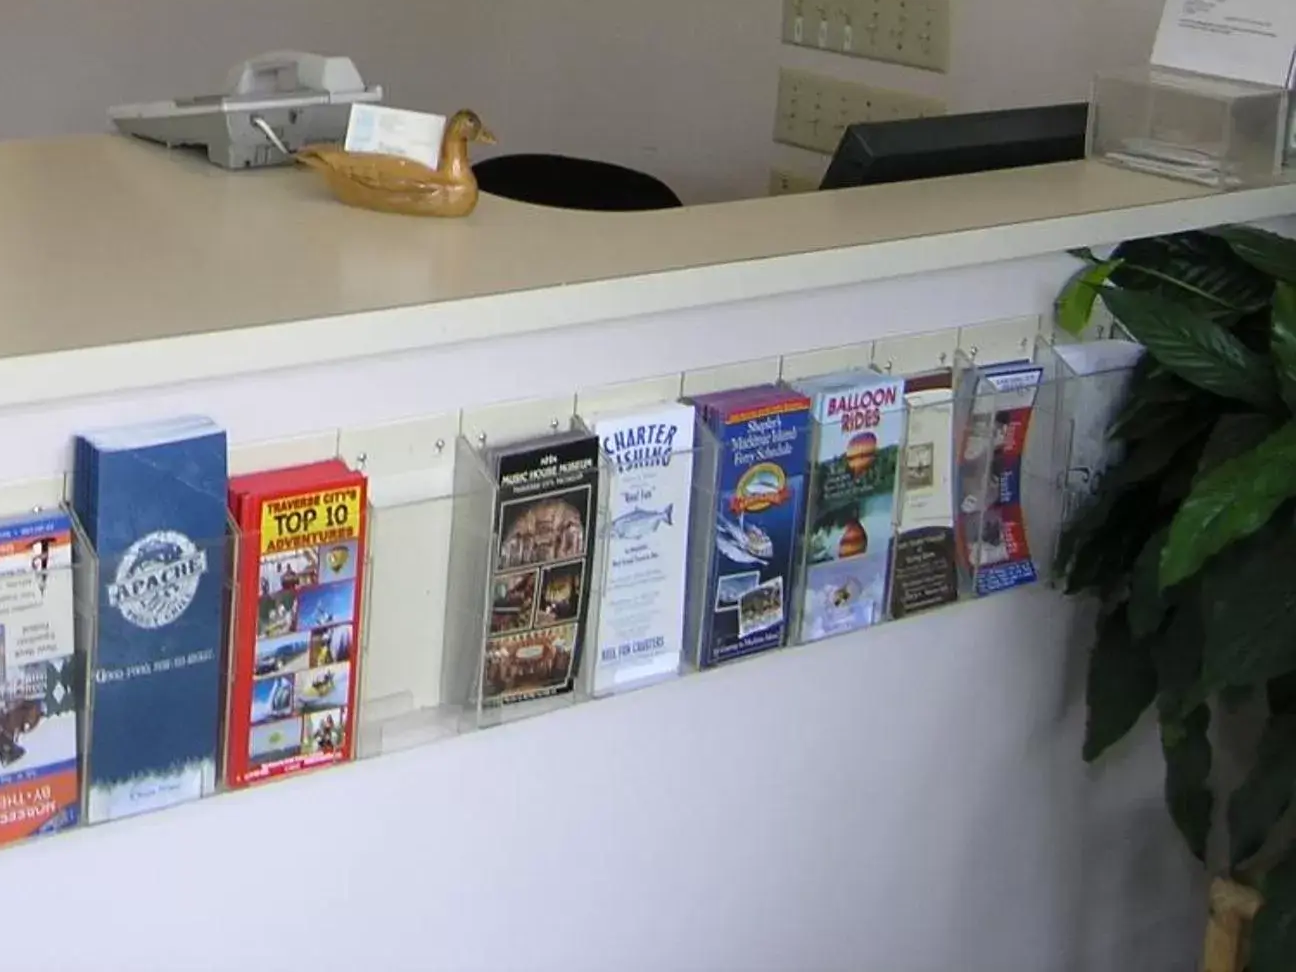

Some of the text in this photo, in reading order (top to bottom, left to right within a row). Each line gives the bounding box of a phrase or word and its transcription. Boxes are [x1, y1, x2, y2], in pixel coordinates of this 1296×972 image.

[827, 385, 898, 417] BALLOON
[840, 408, 881, 432] RIDES
[603, 423, 678, 454] CHARTER
[267, 489, 357, 515] TRAVERSE CITY'S
[273, 503, 349, 536] TOP 10
[266, 526, 355, 551] ADVENTURES
[115, 558, 202, 602] APACHE
